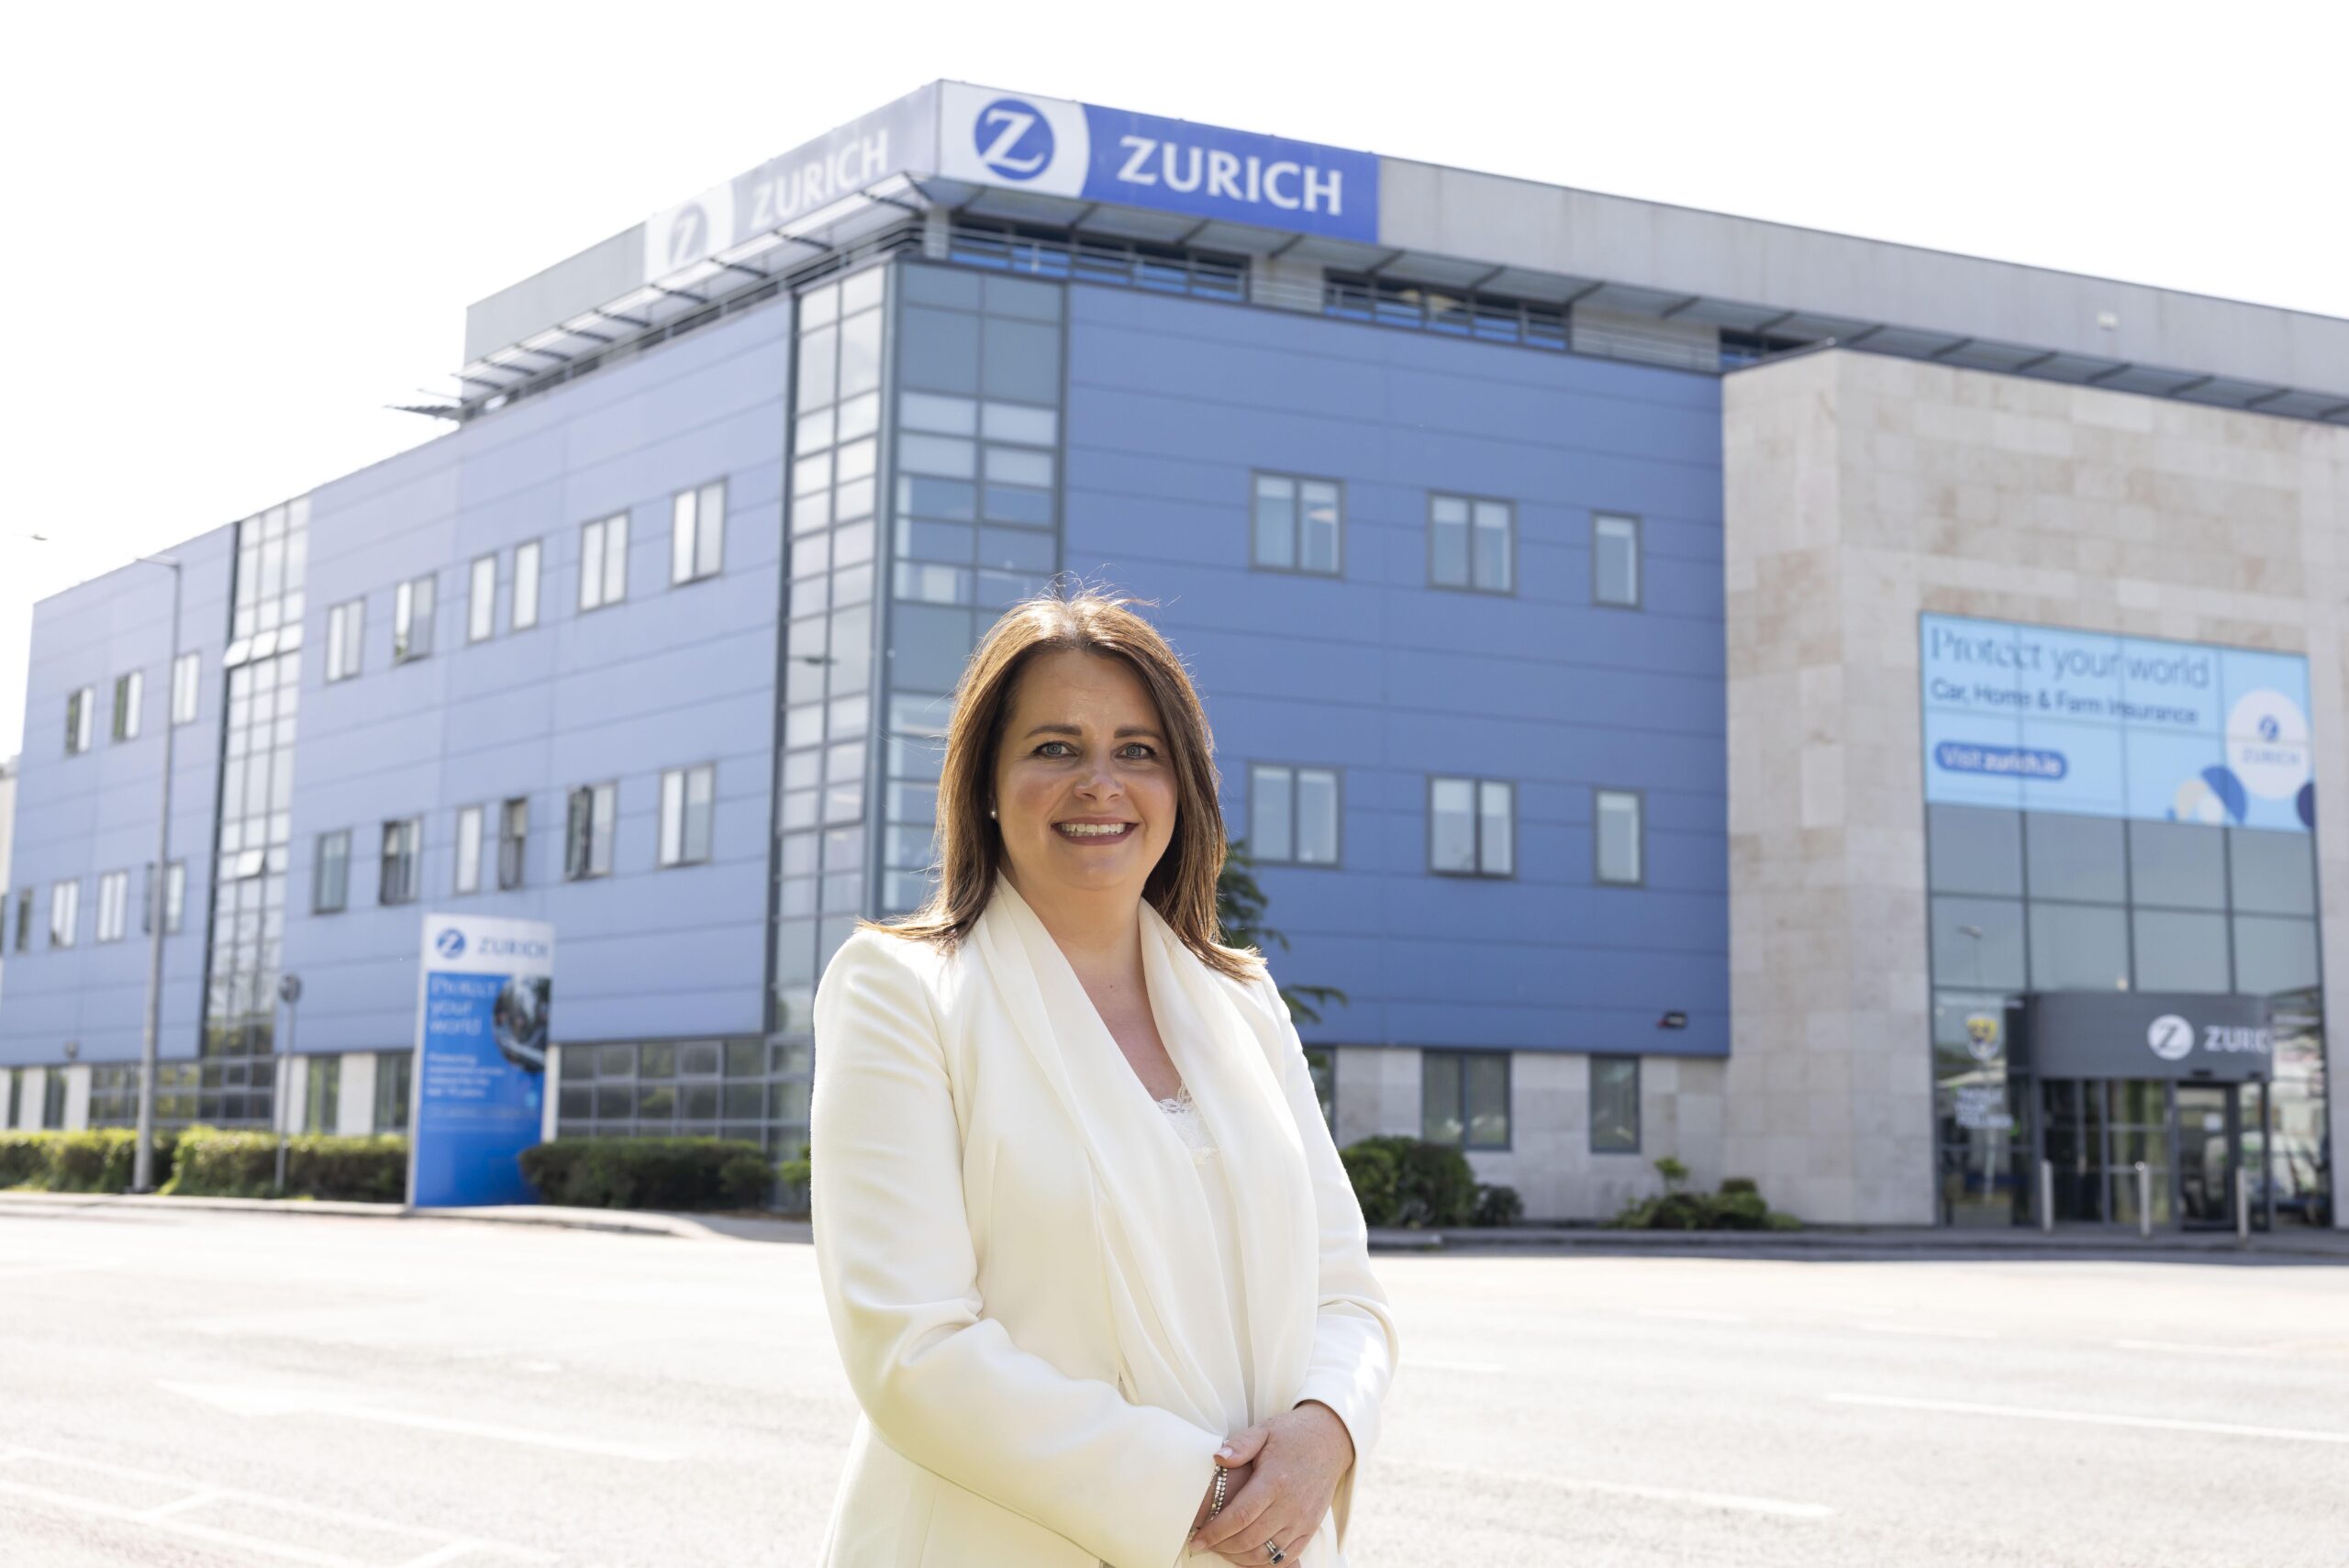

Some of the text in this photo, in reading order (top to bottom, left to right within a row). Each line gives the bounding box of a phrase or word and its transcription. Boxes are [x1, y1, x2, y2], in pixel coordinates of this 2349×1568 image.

[751, 130, 889, 227] ZURICH
[1118, 135, 1343, 217] ZURICH
[1930, 626, 2210, 689] Protect your world
[1931, 677, 2199, 726] Car, Home & Farm Insurance
[1942, 746, 2061, 778] Visit zurich.ie
[477, 935, 548, 959] ZURICH
[429, 1017, 482, 1037] world
